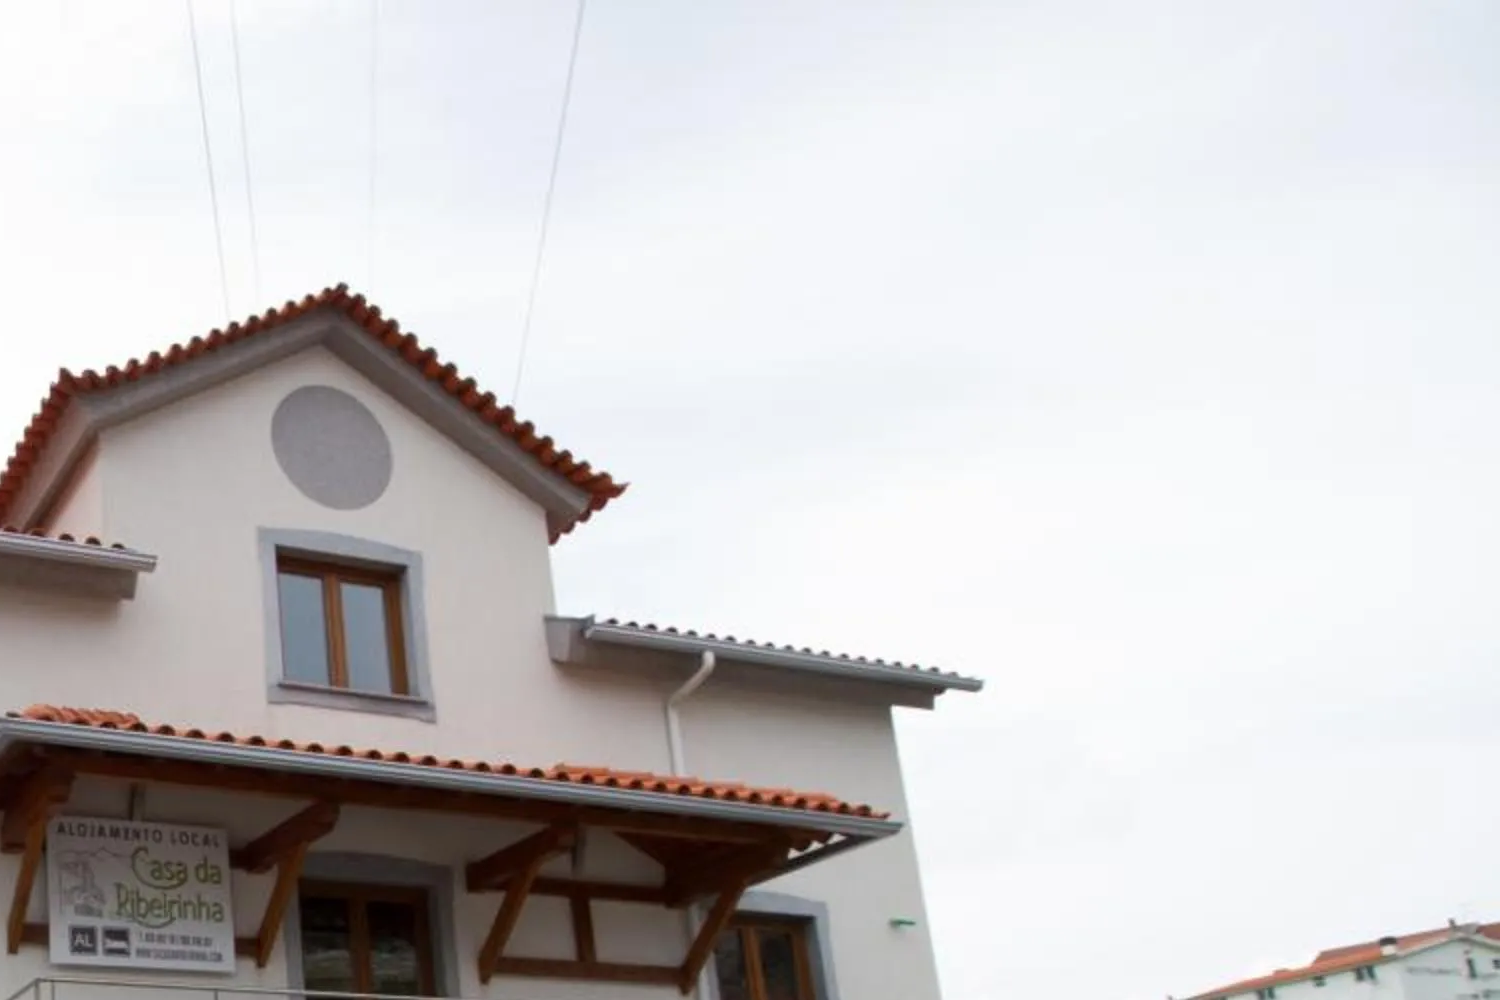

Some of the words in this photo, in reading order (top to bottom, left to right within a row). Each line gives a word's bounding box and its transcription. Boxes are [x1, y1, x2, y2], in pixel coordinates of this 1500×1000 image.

[171, 830, 220, 848] LOCAL
[131, 846, 188, 890] Casa
[195, 856, 222, 885] da
[113, 882, 225, 928] Ribeirinha
[73, 935, 93, 948] AL
